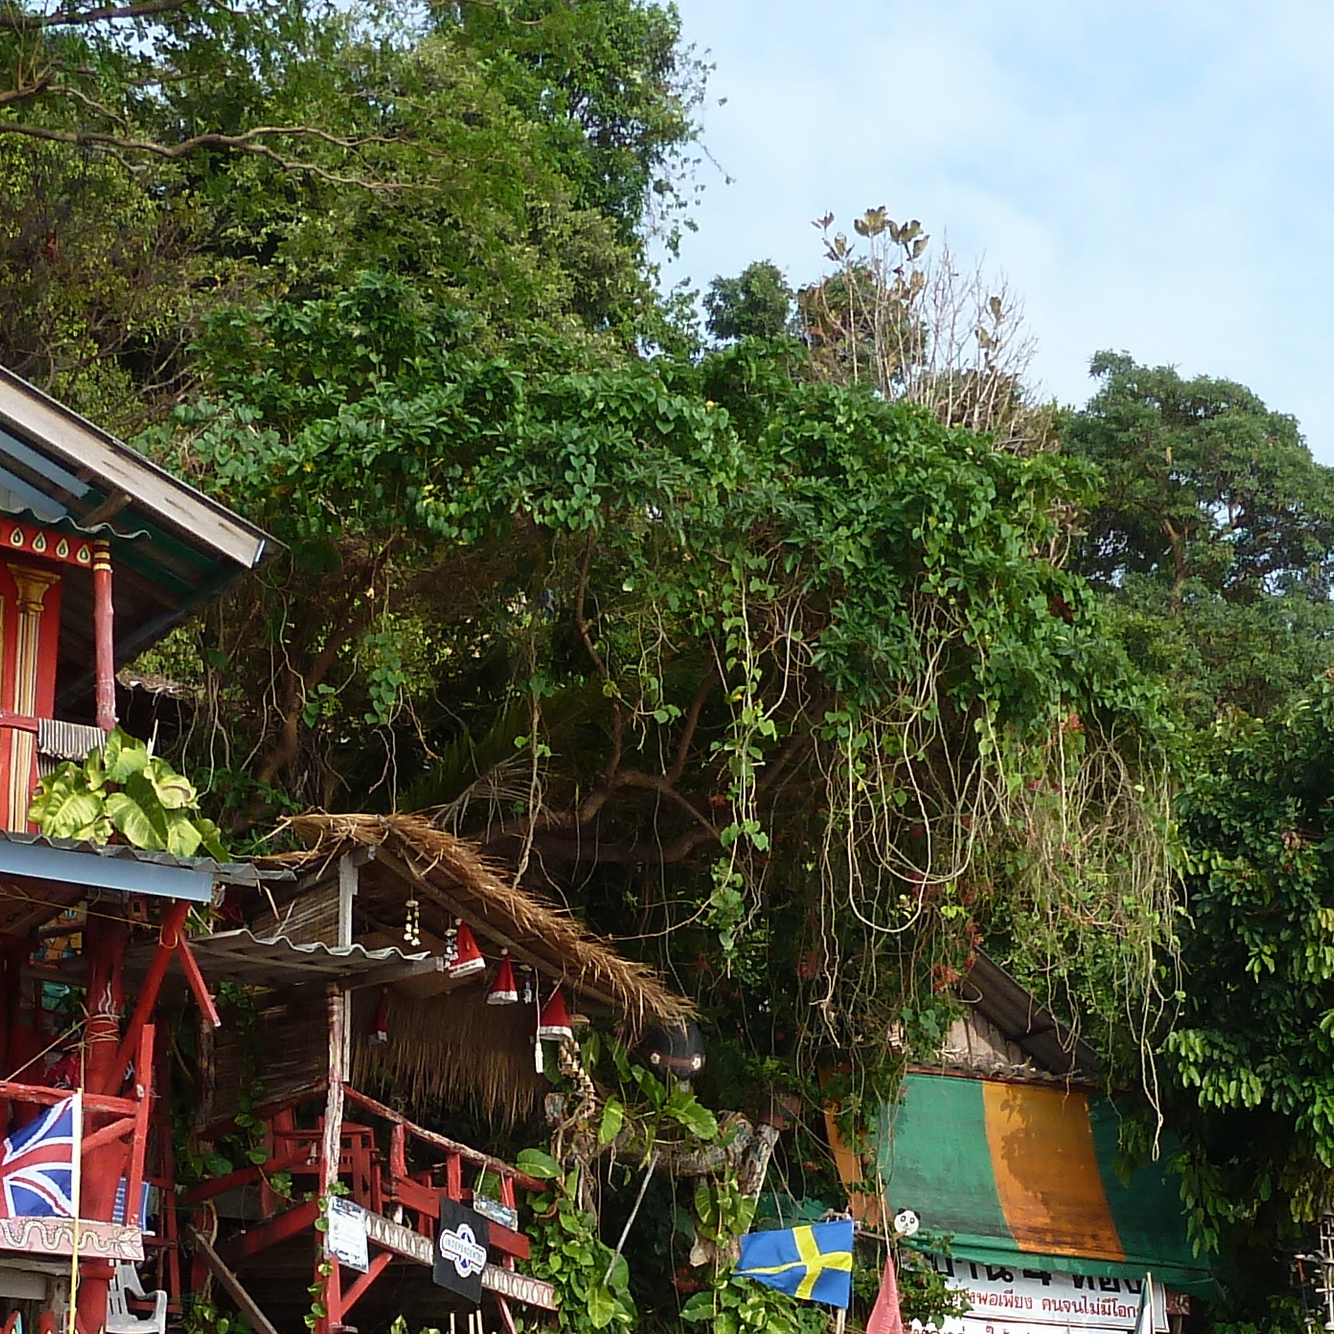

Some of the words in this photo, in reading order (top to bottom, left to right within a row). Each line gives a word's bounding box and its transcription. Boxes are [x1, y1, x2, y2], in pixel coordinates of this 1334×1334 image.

[1042, 1295, 1140, 1319] คนจนไม่มีโอก
